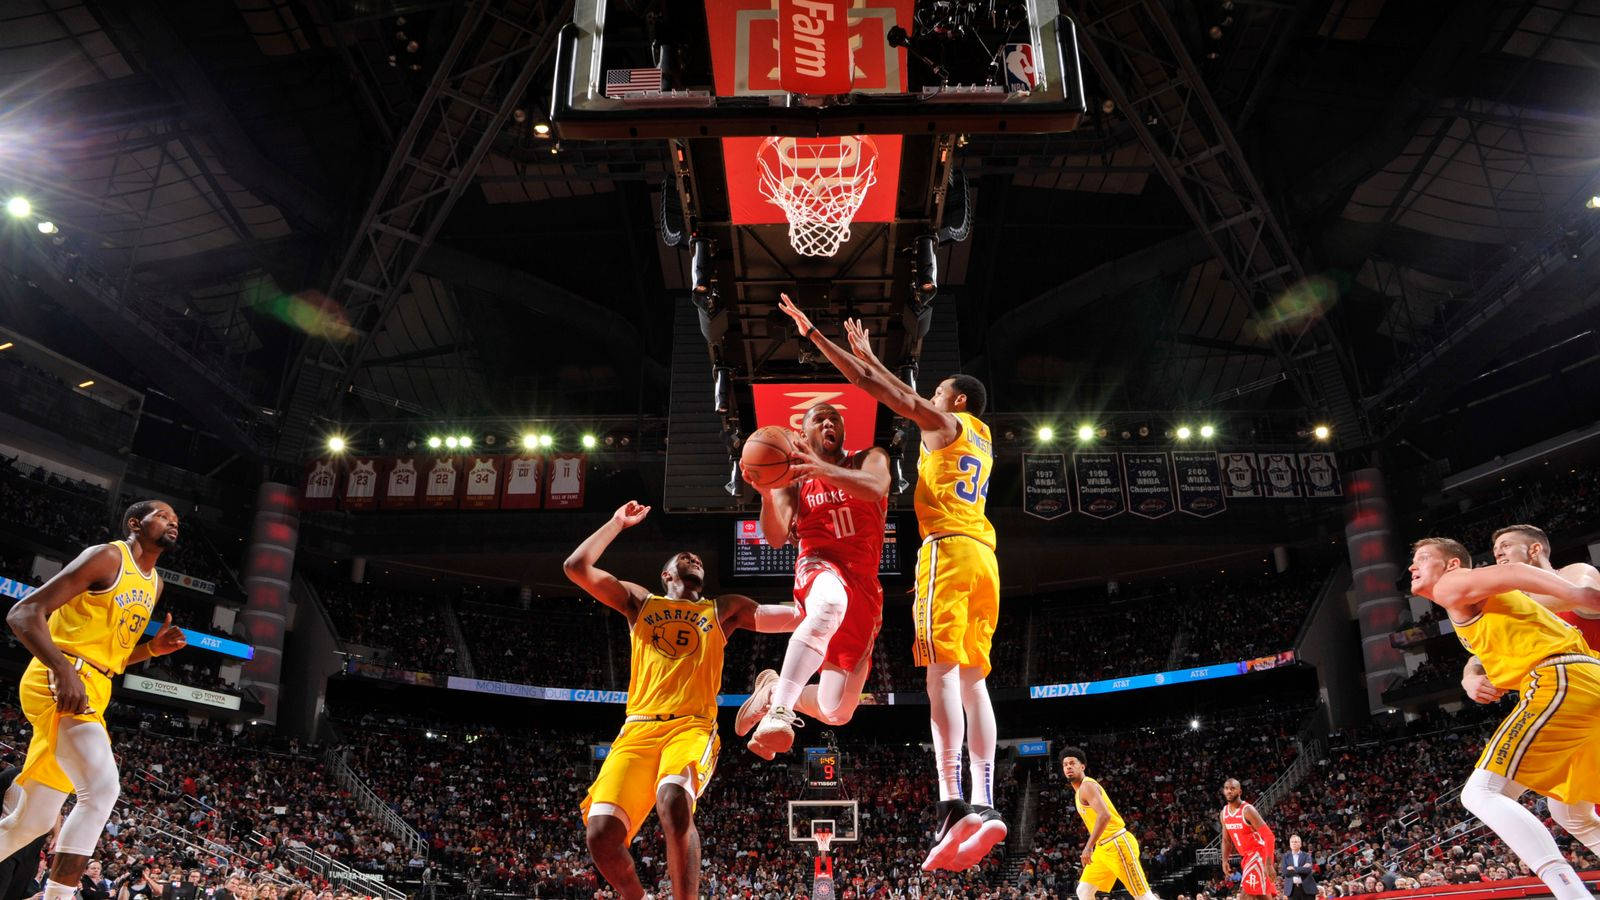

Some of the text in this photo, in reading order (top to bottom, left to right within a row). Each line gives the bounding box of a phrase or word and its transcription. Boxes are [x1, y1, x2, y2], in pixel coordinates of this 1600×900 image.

[792, 0, 834, 78] Farm
[316, 476, 328, 486] 45
[357, 475, 368, 485] 23
[397, 474, 409, 484] 24
[436, 474, 448, 484] 22
[475, 474, 489, 484] 34
[1034, 478, 1056, 486] WNBA
[1087, 477, 1111, 485] WNBA
[1136, 477, 1160, 485] WNBA
[1026, 486, 1066, 494] Champions
[1080, 486, 1120, 494] Champions
[1130, 486, 1169, 494] Champions
[1180, 484, 1220, 493] Champions
[806, 489, 852, 508] ROCKE
[828, 507, 856, 539] 10
[643, 609, 713, 632] WARRIORS
[200, 637, 222, 648] AT&T
[676, 630, 691, 646] 5
[1190, 668, 1209, 678] AT&T
[155, 682, 179, 691] TOYOTA
[1112, 679, 1131, 689] AT&T
[475, 681, 536, 697] MOBILIZING
[540, 686, 569, 700] YOUR
[1030, 682, 1091, 699] MEDAY
[204, 692, 226, 702] TOYOTA
[1495, 711, 1536, 765] WARRIORS
[820, 757, 835, 765] 1:45
[824, 765, 834, 780] 9
[1233, 832, 1241, 846] 1
